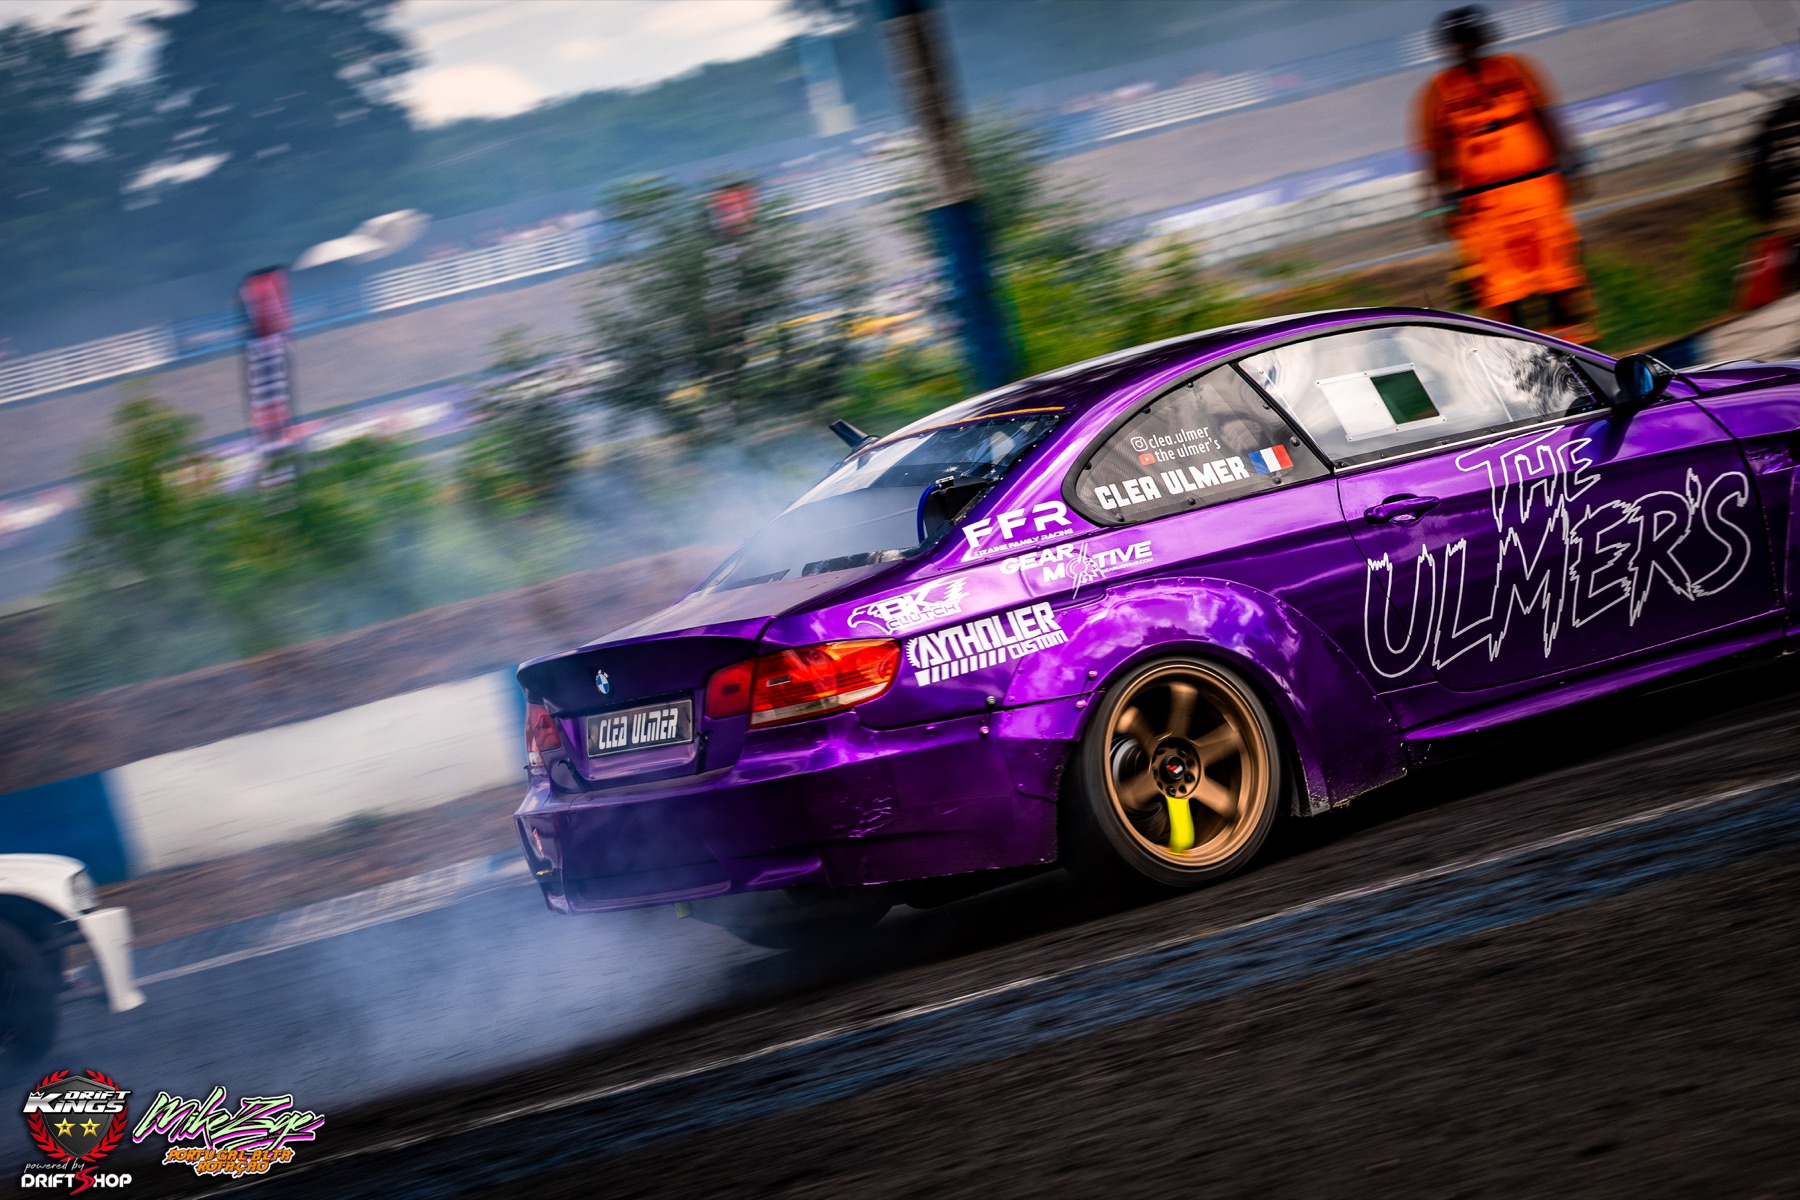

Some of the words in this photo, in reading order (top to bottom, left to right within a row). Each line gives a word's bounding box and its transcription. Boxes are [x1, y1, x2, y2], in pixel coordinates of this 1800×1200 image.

[1148, 426, 1210, 449] clea.ulmer
[1155, 446, 1176, 463] the
[1180, 438, 1221, 458] ulmer's
[1094, 475, 1162, 510] CLEA
[1160, 455, 1250, 495] ULMER
[1455, 424, 1602, 532] THE
[961, 500, 1073, 557] FFR
[1008, 536, 1040, 549] FAMILY
[1041, 527, 1075, 541] RACING
[1000, 543, 1076, 575] GEAR
[1364, 467, 1752, 679] ULMER'S
[887, 602, 960, 630] CLUTCH
[1006, 629, 1070, 660] CUSTOM
[599, 716, 627, 749] CLEA
[631, 708, 678, 744] ULMER
